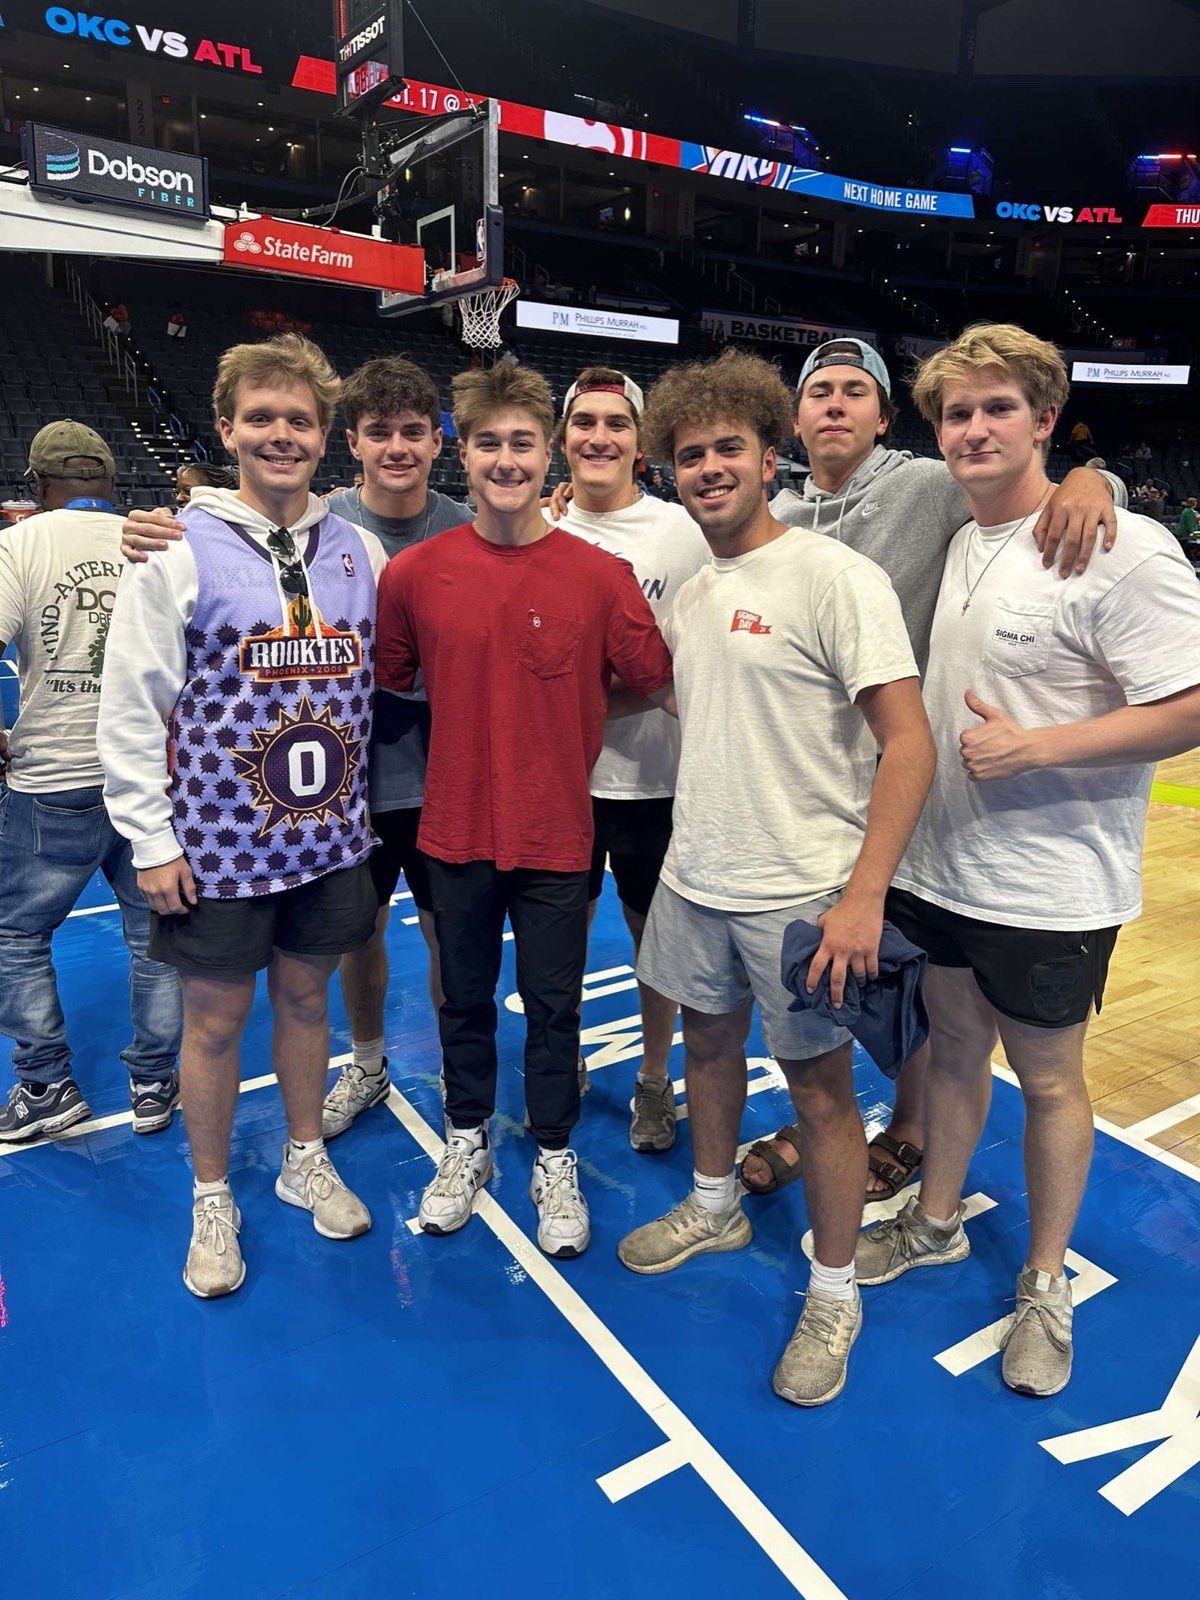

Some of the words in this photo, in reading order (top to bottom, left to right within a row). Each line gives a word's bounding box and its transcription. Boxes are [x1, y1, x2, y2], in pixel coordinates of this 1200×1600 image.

[45, 7, 131, 46] OKC
[136, 25, 188, 58] VS
[194, 39, 262, 74] ATL
[420, 88, 438, 110] 17
[88, 150, 194, 192] Dobson
[138, 187, 195, 207] FIBER
[844, 182, 869, 202] NEXT
[870, 188, 902, 208] HOME
[905, 192, 938, 211] GAME
[996, 201, 1041, 221] OKC
[1043, 205, 1073, 223] VS
[1076, 207, 1123, 223] ATL
[1175, 208, 1200, 224] THU
[263, 236, 354, 269] StateFarm
[552, 311, 569, 326] PM
[575, 312, 605, 325] PHILLIPS
[607, 317, 640, 329] MURRAH
[730, 320, 848, 345] BASKETBA
[1086, 367, 1100, 378] PM
[995, 628, 1018, 641] SIGMA
[1020, 634, 1035, 643] CHI
[250, 638, 355, 668] ROOKIES
[265, 666, 308, 676] PHOENIX
[288, 740, 326, 797] 0
